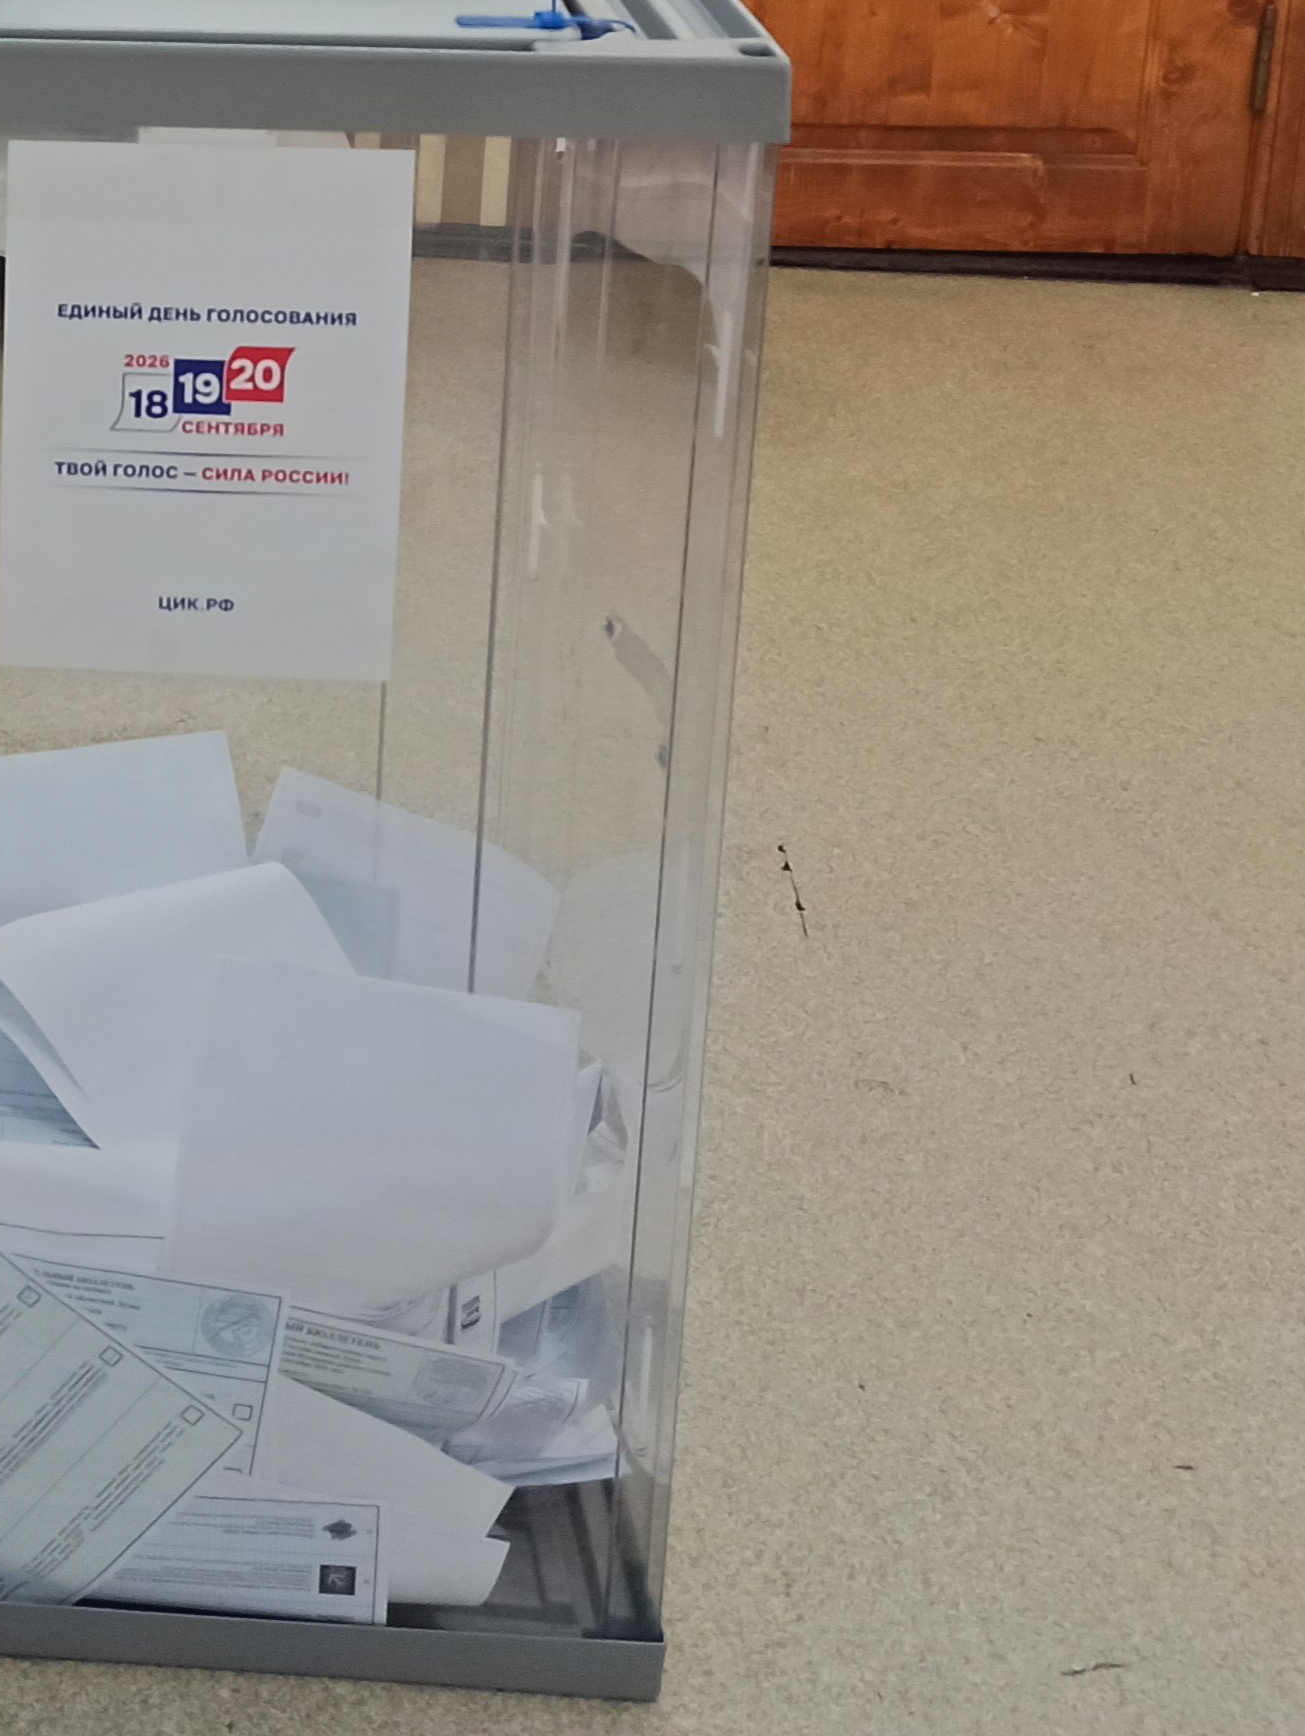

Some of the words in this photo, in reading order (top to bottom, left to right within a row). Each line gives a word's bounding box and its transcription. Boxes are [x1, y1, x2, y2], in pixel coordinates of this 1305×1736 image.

[57, 302, 143, 320] ЕДИНЫЙ
[148, 307, 201, 323] ДЕНЬ
[206, 308, 358, 327] ГОЛОСОВАНИЯ
[123, 354, 171, 369] 2026
[128, 388, 169, 419] 18
[177, 371, 221, 405] 19
[229, 358, 282, 391] 20
[181, 420, 285, 437] СЕНТЯБРЯ
[54, 460, 107, 477] ТВОЙ
[112, 464, 178, 479] ГОЛОС
[201, 466, 256, 482] СИЛА
[261, 469, 350, 485] РОССИИ!
